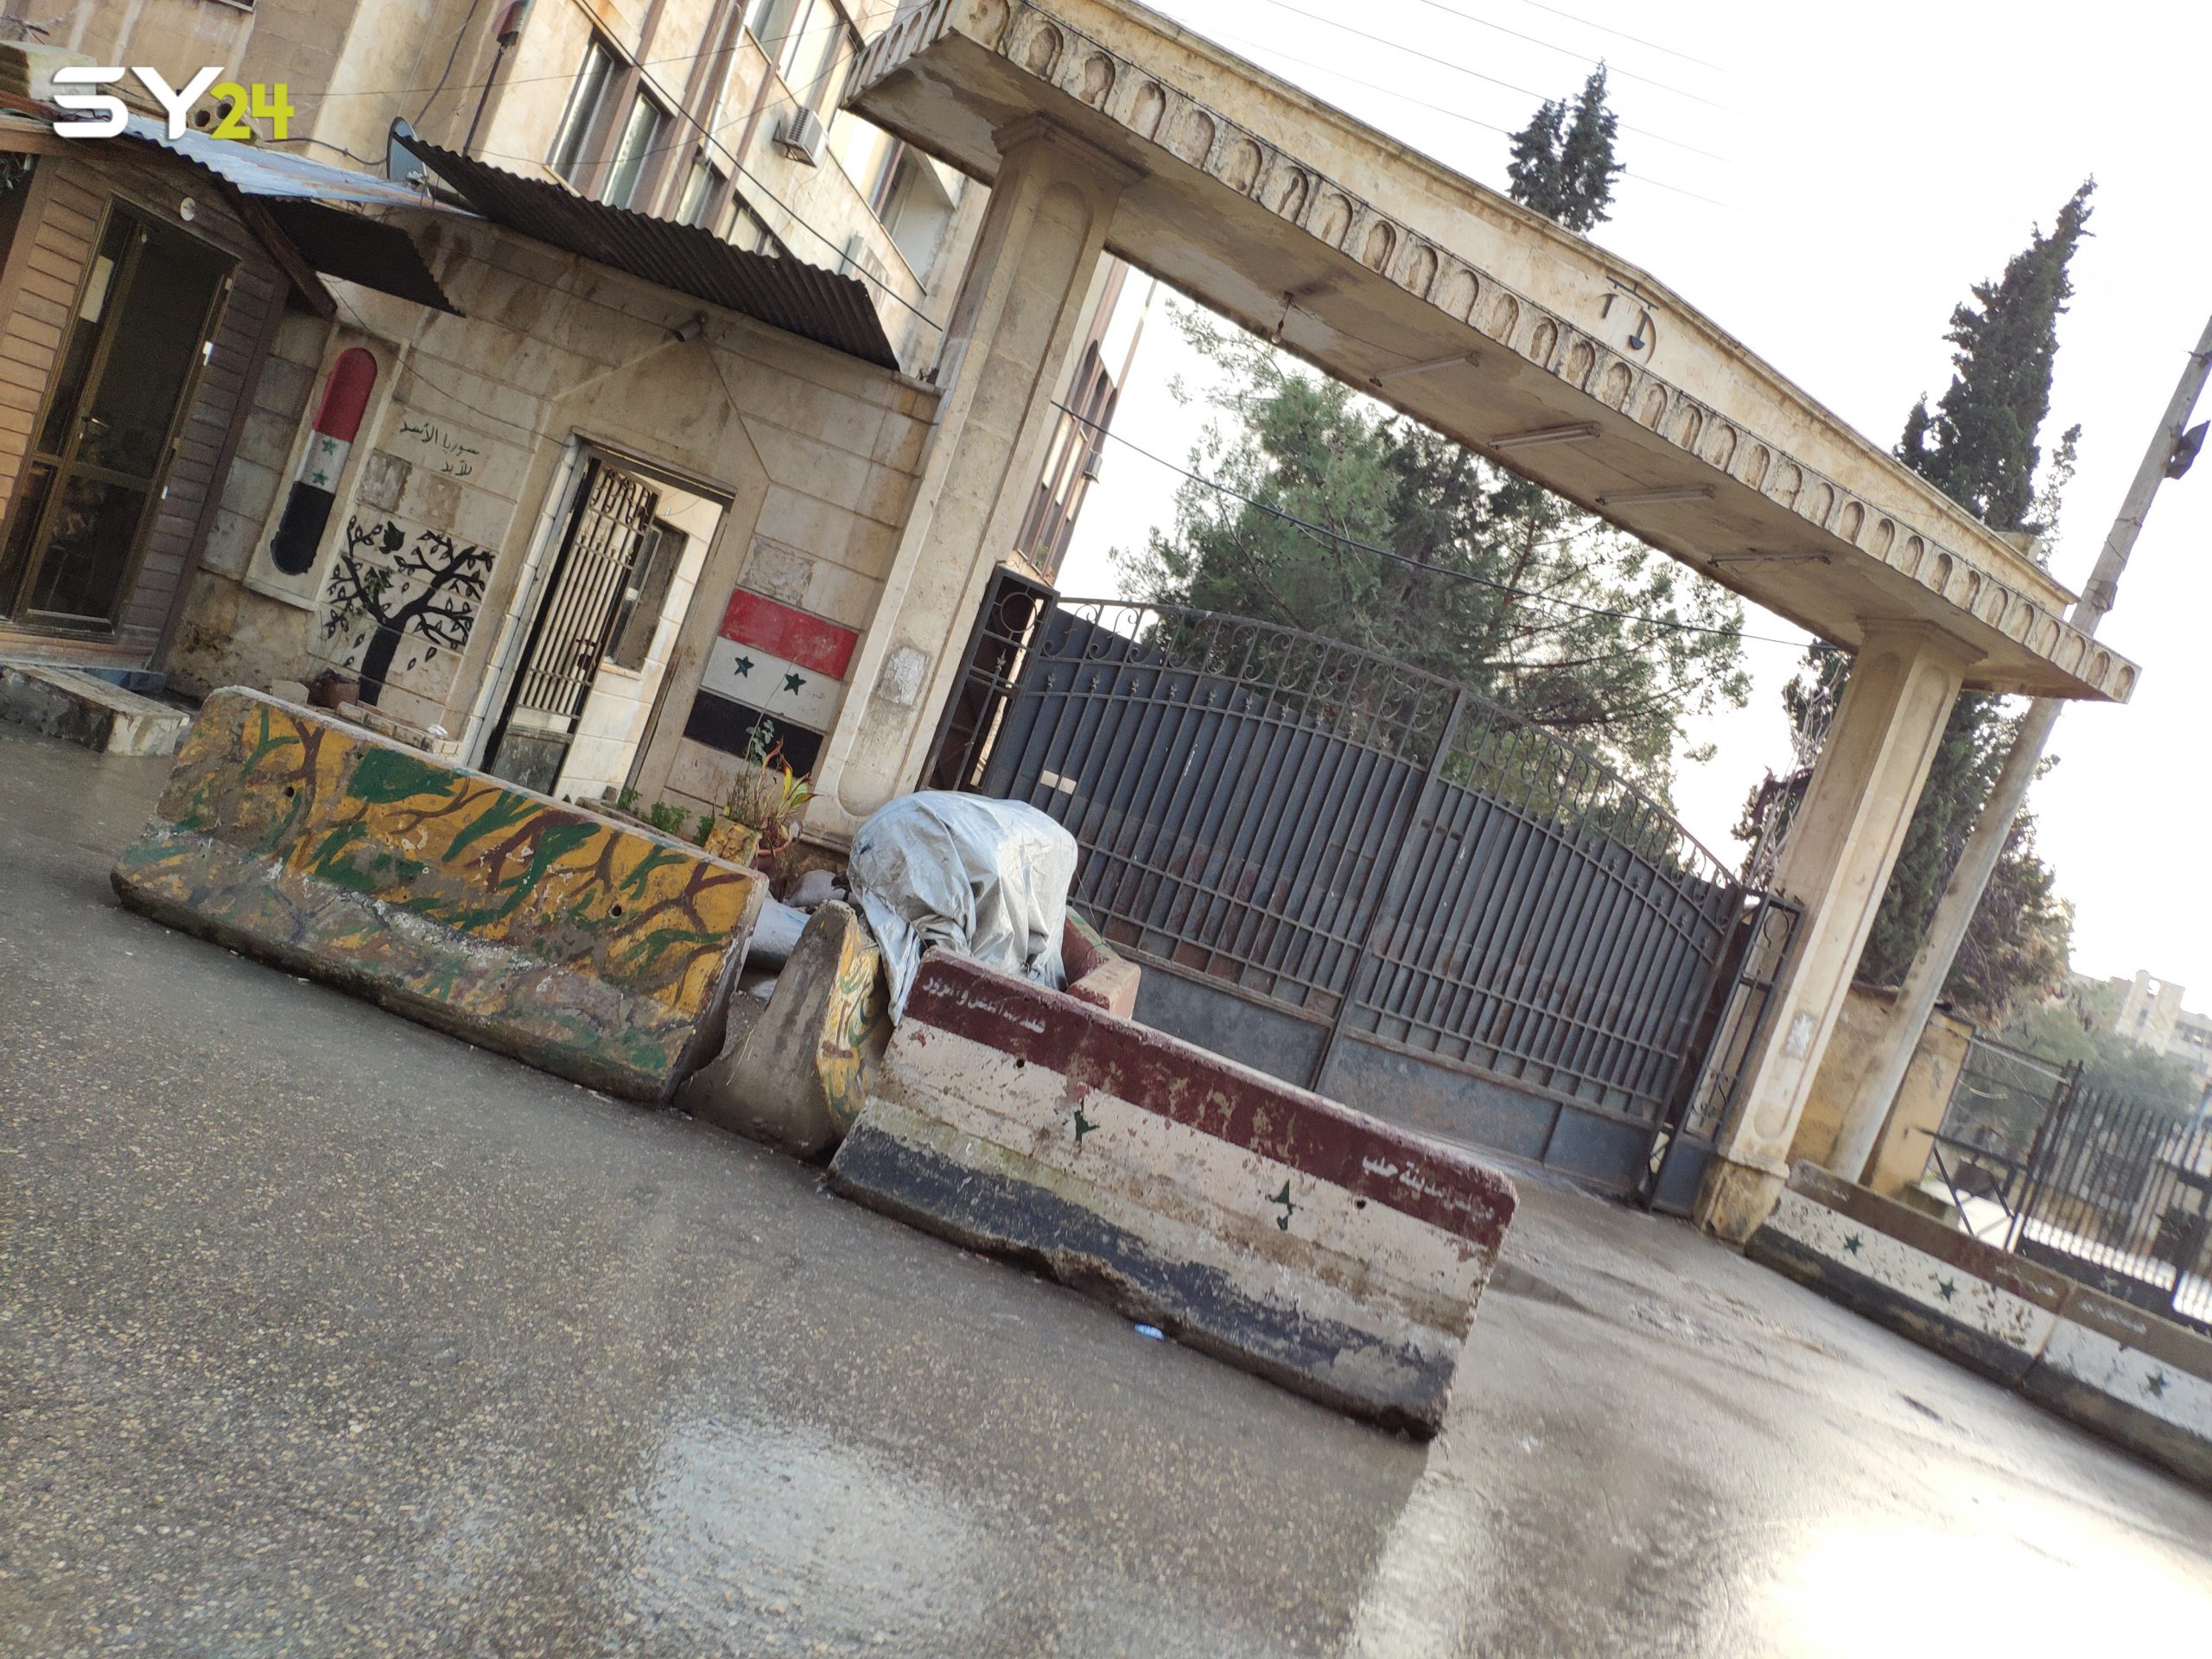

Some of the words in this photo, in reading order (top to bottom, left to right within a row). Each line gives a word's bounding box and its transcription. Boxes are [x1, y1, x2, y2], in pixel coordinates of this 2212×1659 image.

[399, 421, 438, 445] الأسد
[442, 433, 480, 457] سوريا
[441, 460, 473, 476] للأبد
[1362, 1154, 1399, 1177] حلب
[1399, 1160, 1444, 1200] مدينة
